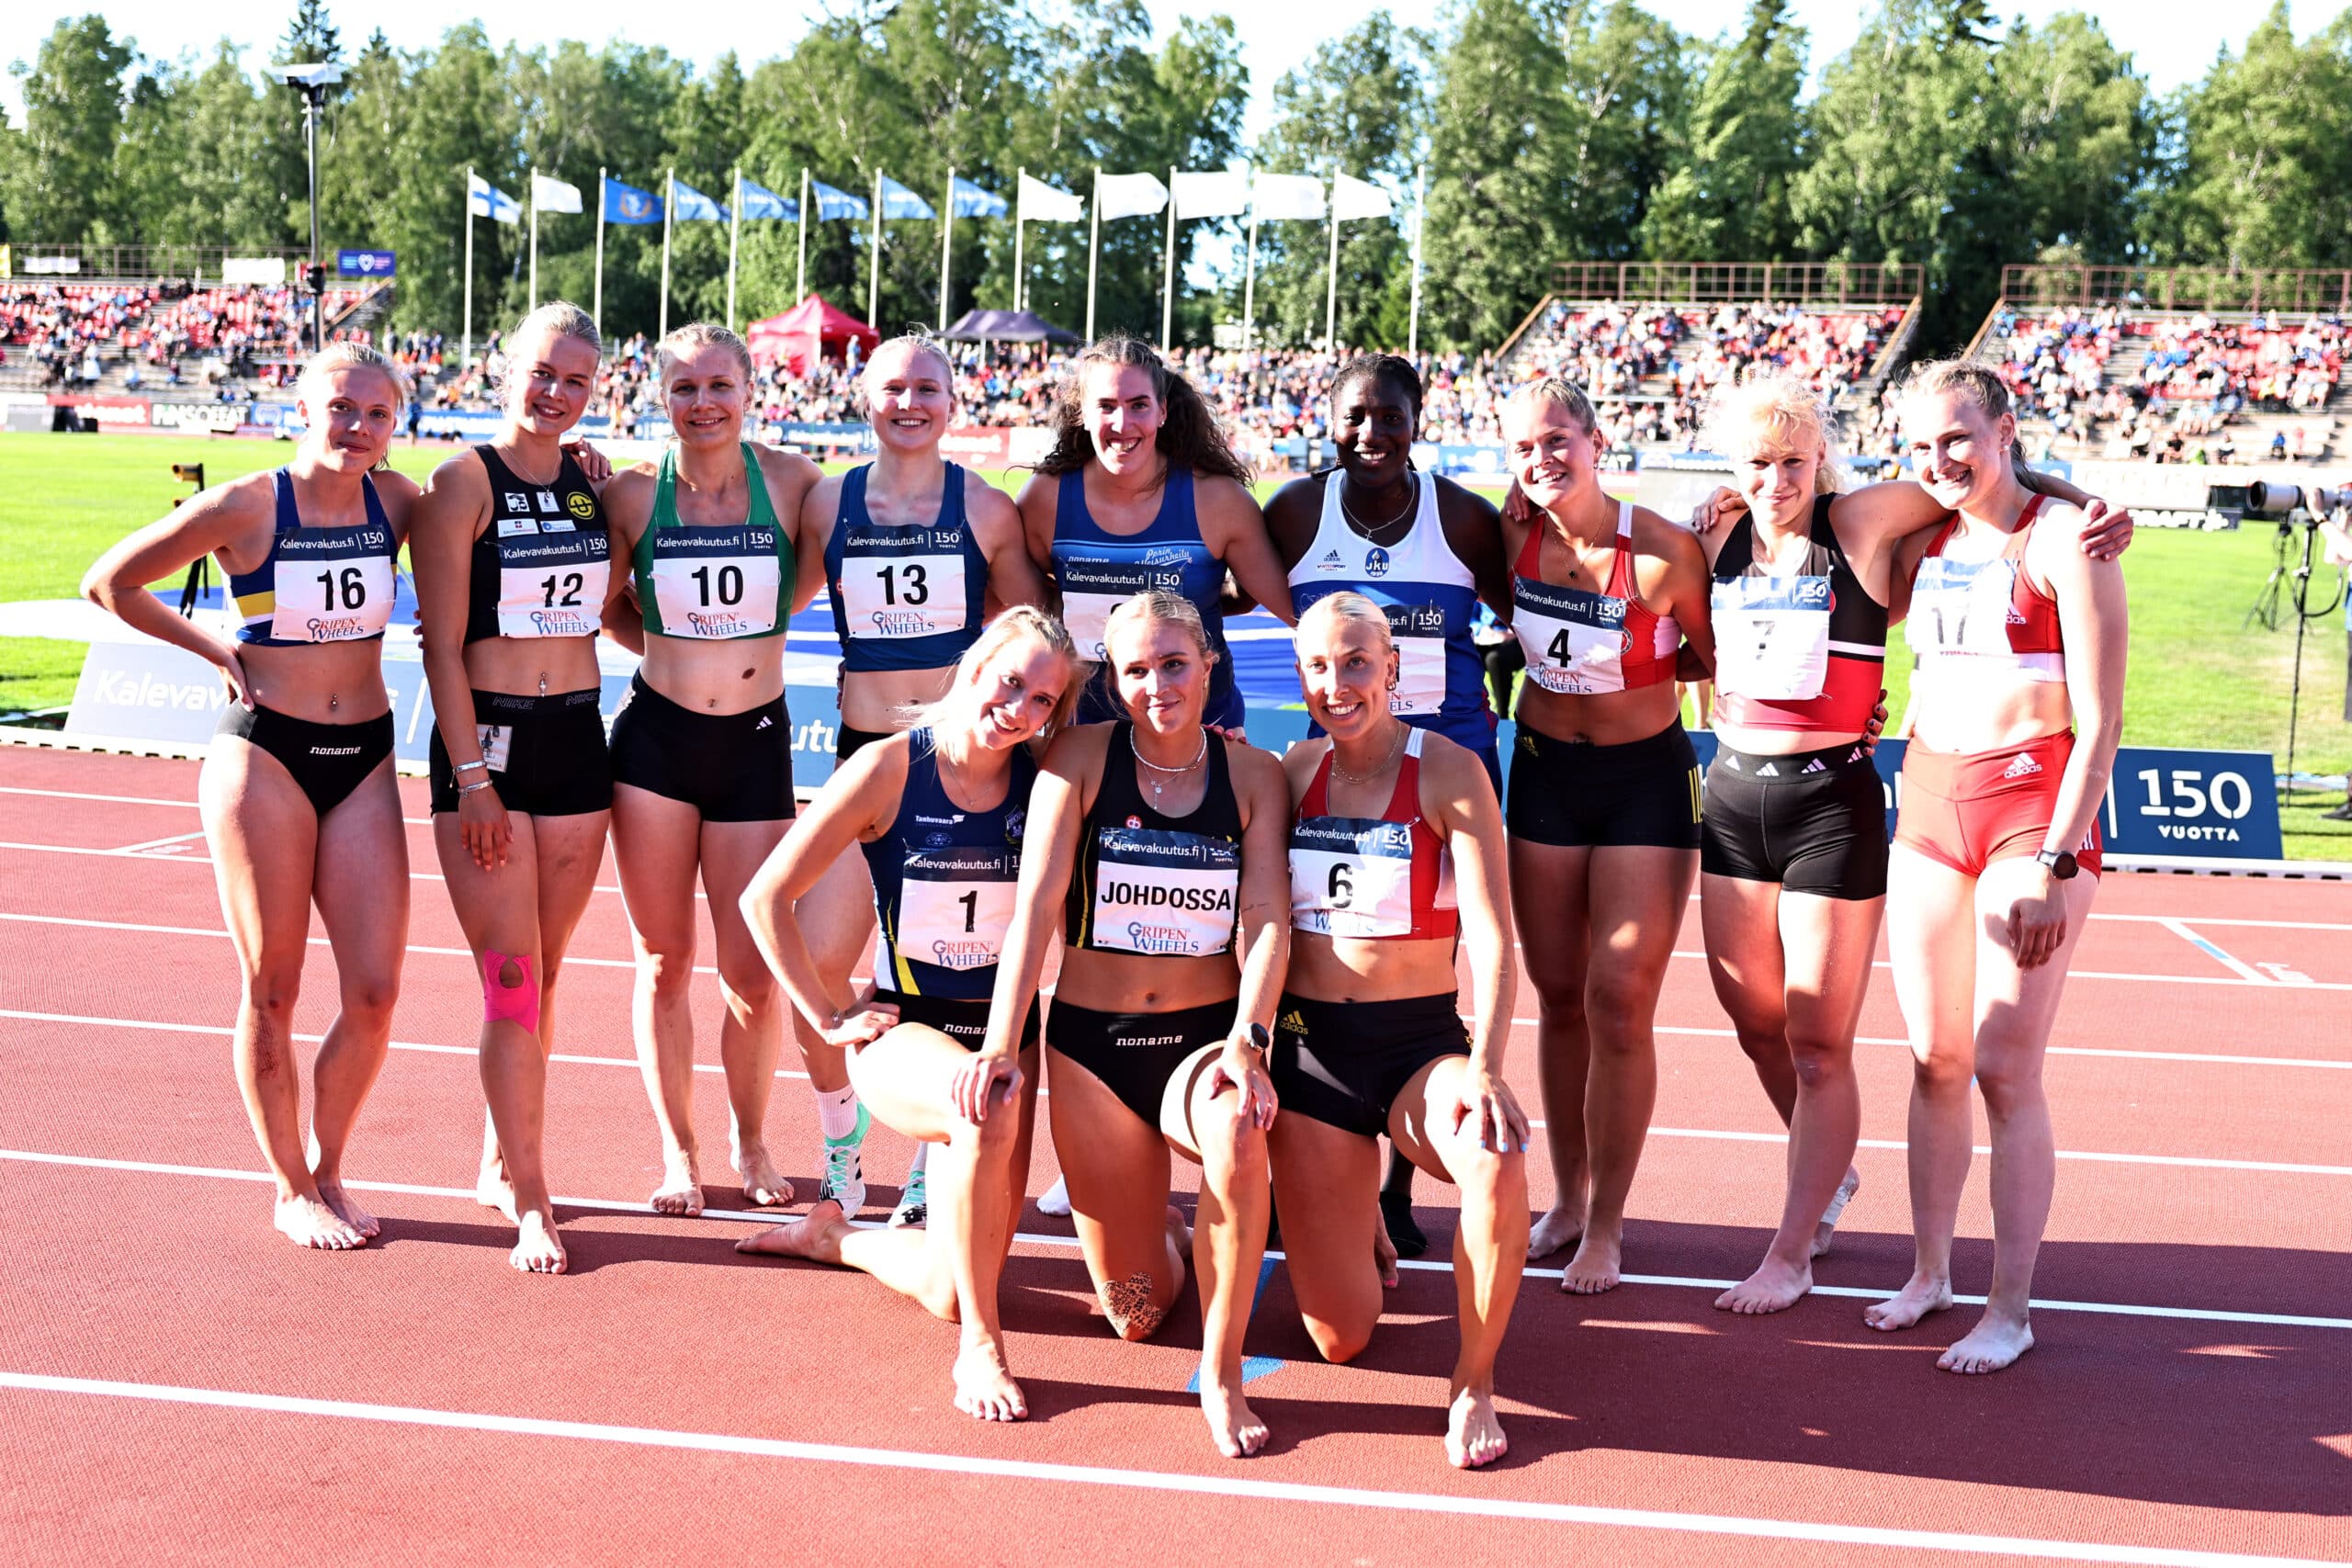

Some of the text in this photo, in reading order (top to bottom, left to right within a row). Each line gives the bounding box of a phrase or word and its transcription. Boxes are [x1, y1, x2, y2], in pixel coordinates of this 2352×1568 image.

[362, 532, 384, 545] 150
[657, 533, 773, 548] Kalevavakuutus.fi 150
[847, 532, 959, 547] Kalevavakuutus.fi 150
[503, 538, 606, 559] Kalevavakuutus.fi 150
[876, 564, 928, 605] 13
[1066, 570, 1180, 586] Kalevavakuutus.fi 150
[317, 568, 366, 611] 16
[541, 572, 583, 608] 12
[691, 566, 743, 606] 10
[530, 611, 580, 624] GRIPEN
[872, 611, 923, 624] GRIPEN
[1597, 603, 1622, 618] 150
[307, 617, 356, 630] GRIPEN
[687, 612, 736, 626] GRIPEN
[1419, 613, 1442, 626] 150
[2006, 615, 2027, 625] das
[311, 626, 364, 639] WHEELS
[537, 622, 588, 635] WHEELS
[694, 621, 747, 636] WHEELS
[876, 621, 934, 635] WHEELS
[1752, 620, 1775, 660] 7
[1547, 627, 1571, 669] 4
[492, 696, 536, 710] NIKE
[1389, 700, 1413, 712] ELS
[310, 746, 361, 755] noname
[2004, 763, 2042, 780] adidas
[2138, 768, 2253, 820] 150
[1382, 829, 1408, 845] 150
[2158, 824, 2241, 842] VUOTTA
[1104, 837, 1199, 857] Kalevavakuutus.fi
[1329, 863, 1352, 909] 6
[1102, 882, 1231, 911] JOHDOSSA
[958, 890, 978, 932] 1
[1127, 921, 1188, 941] GRIPEN
[933, 940, 989, 954] GRIPEN
[1133, 936, 1199, 953] WHEELS
[943, 1023, 988, 1034] nona
[1115, 1035, 1183, 1046] noname
